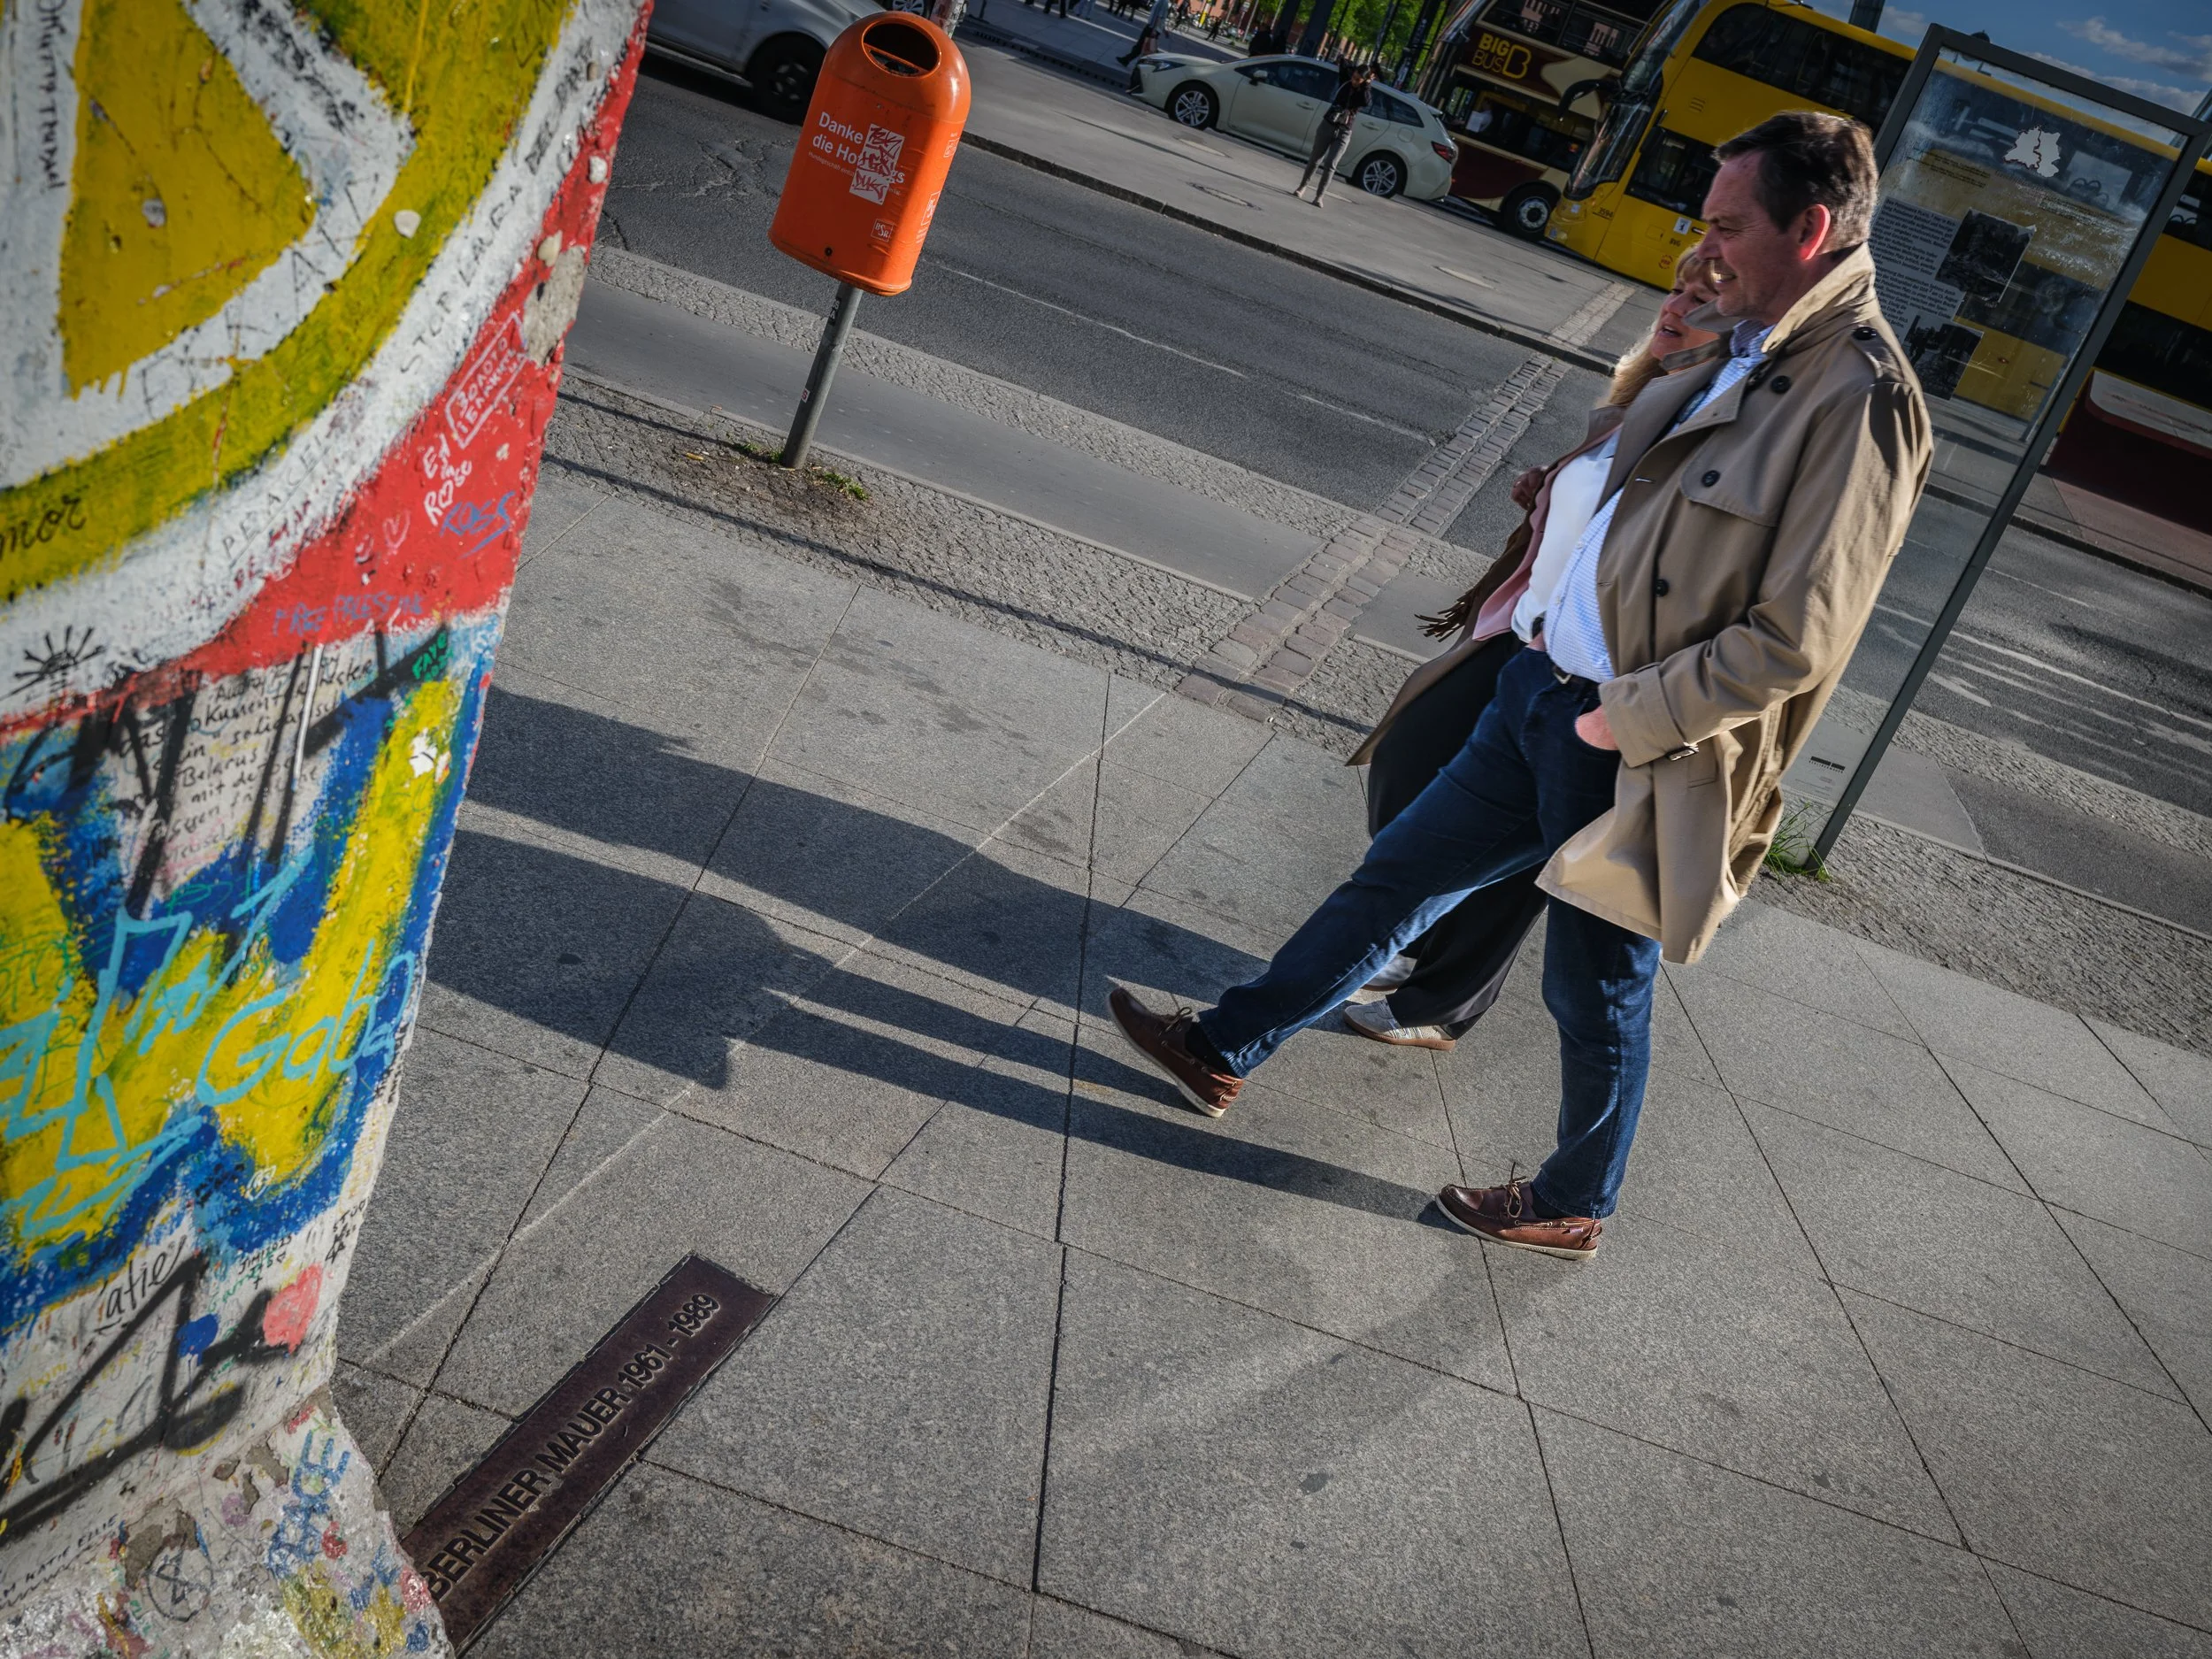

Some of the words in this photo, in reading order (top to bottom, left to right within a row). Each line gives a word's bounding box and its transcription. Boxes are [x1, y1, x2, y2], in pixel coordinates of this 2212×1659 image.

[1479, 33, 1510, 57] BIG
[1471, 49, 1504, 73] BUS
[818, 111, 864, 144] Danke
[812, 134, 833, 153] die
[875, 222, 889, 238] BSR
[426, 1469, 550, 1601] BERLINER
[535, 1386, 629, 1474] MAUER
[618, 1343, 672, 1389] 1961
[668, 1293, 721, 1337] 1989
